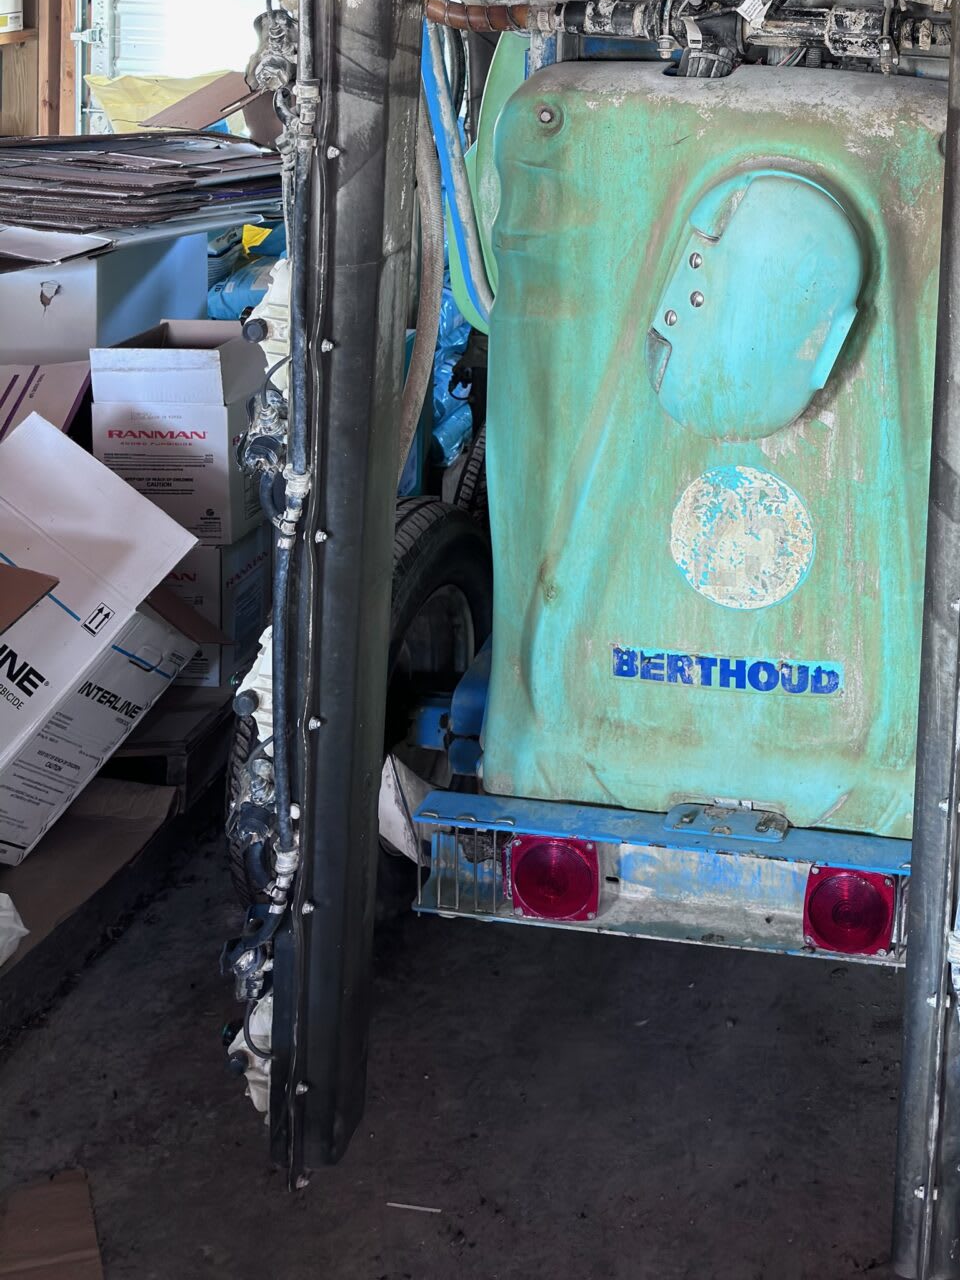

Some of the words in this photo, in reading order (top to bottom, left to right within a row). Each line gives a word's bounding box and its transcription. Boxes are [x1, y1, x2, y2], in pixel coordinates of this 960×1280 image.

[108, 430, 206, 439] RANMAN
[612, 646, 840, 695] BERTHOUD
[78, 680, 143, 719] INTERLINE
